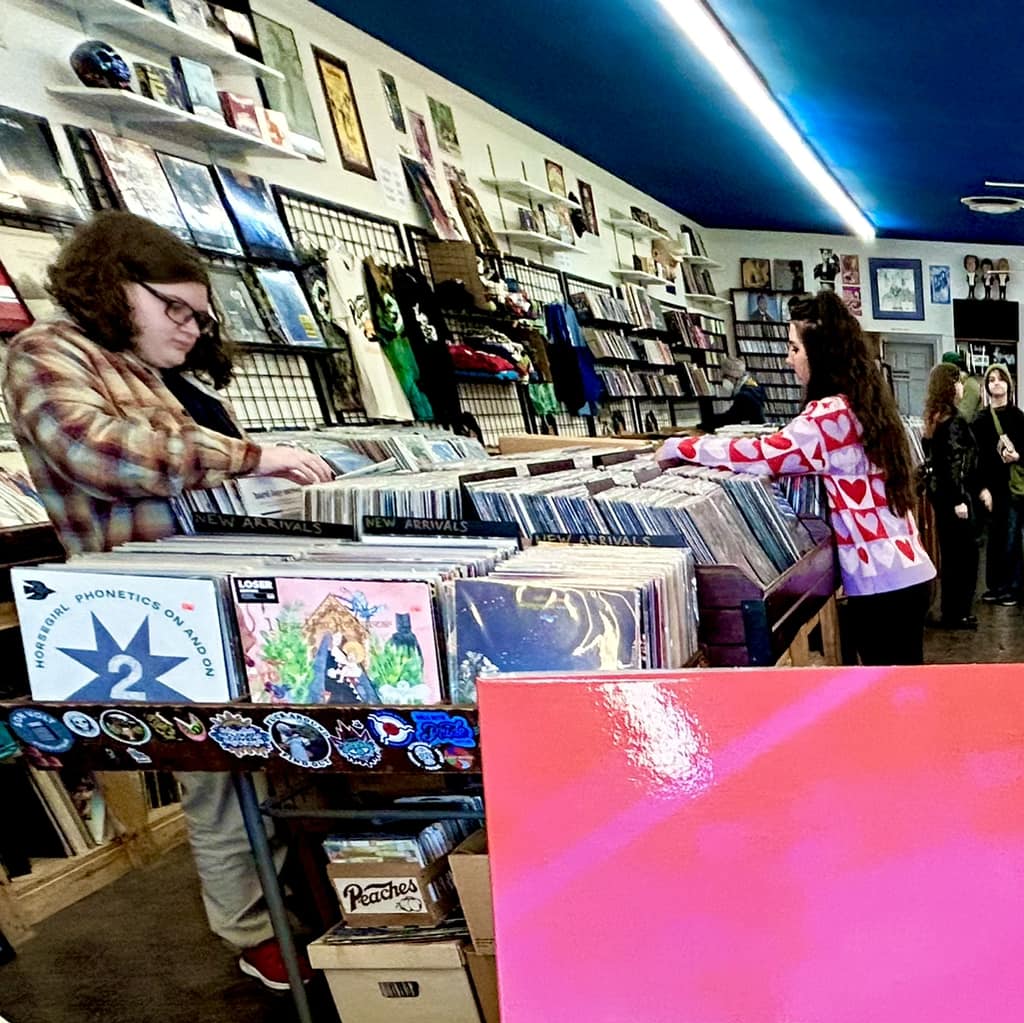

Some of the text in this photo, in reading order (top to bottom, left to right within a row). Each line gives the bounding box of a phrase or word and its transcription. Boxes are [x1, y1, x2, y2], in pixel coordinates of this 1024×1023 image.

[195, 513, 323, 535] NEW ARRIVALS
[365, 517, 469, 533] NEW ARRIVALS
[579, 534, 651, 546] ARRIVALS
[238, 580, 273, 589] LOSER
[35, 589, 215, 677] HORSEGIRL PHONETICS ON AND ON
[108, 654, 147, 701] 2
[343, 878, 418, 913] Peaches
